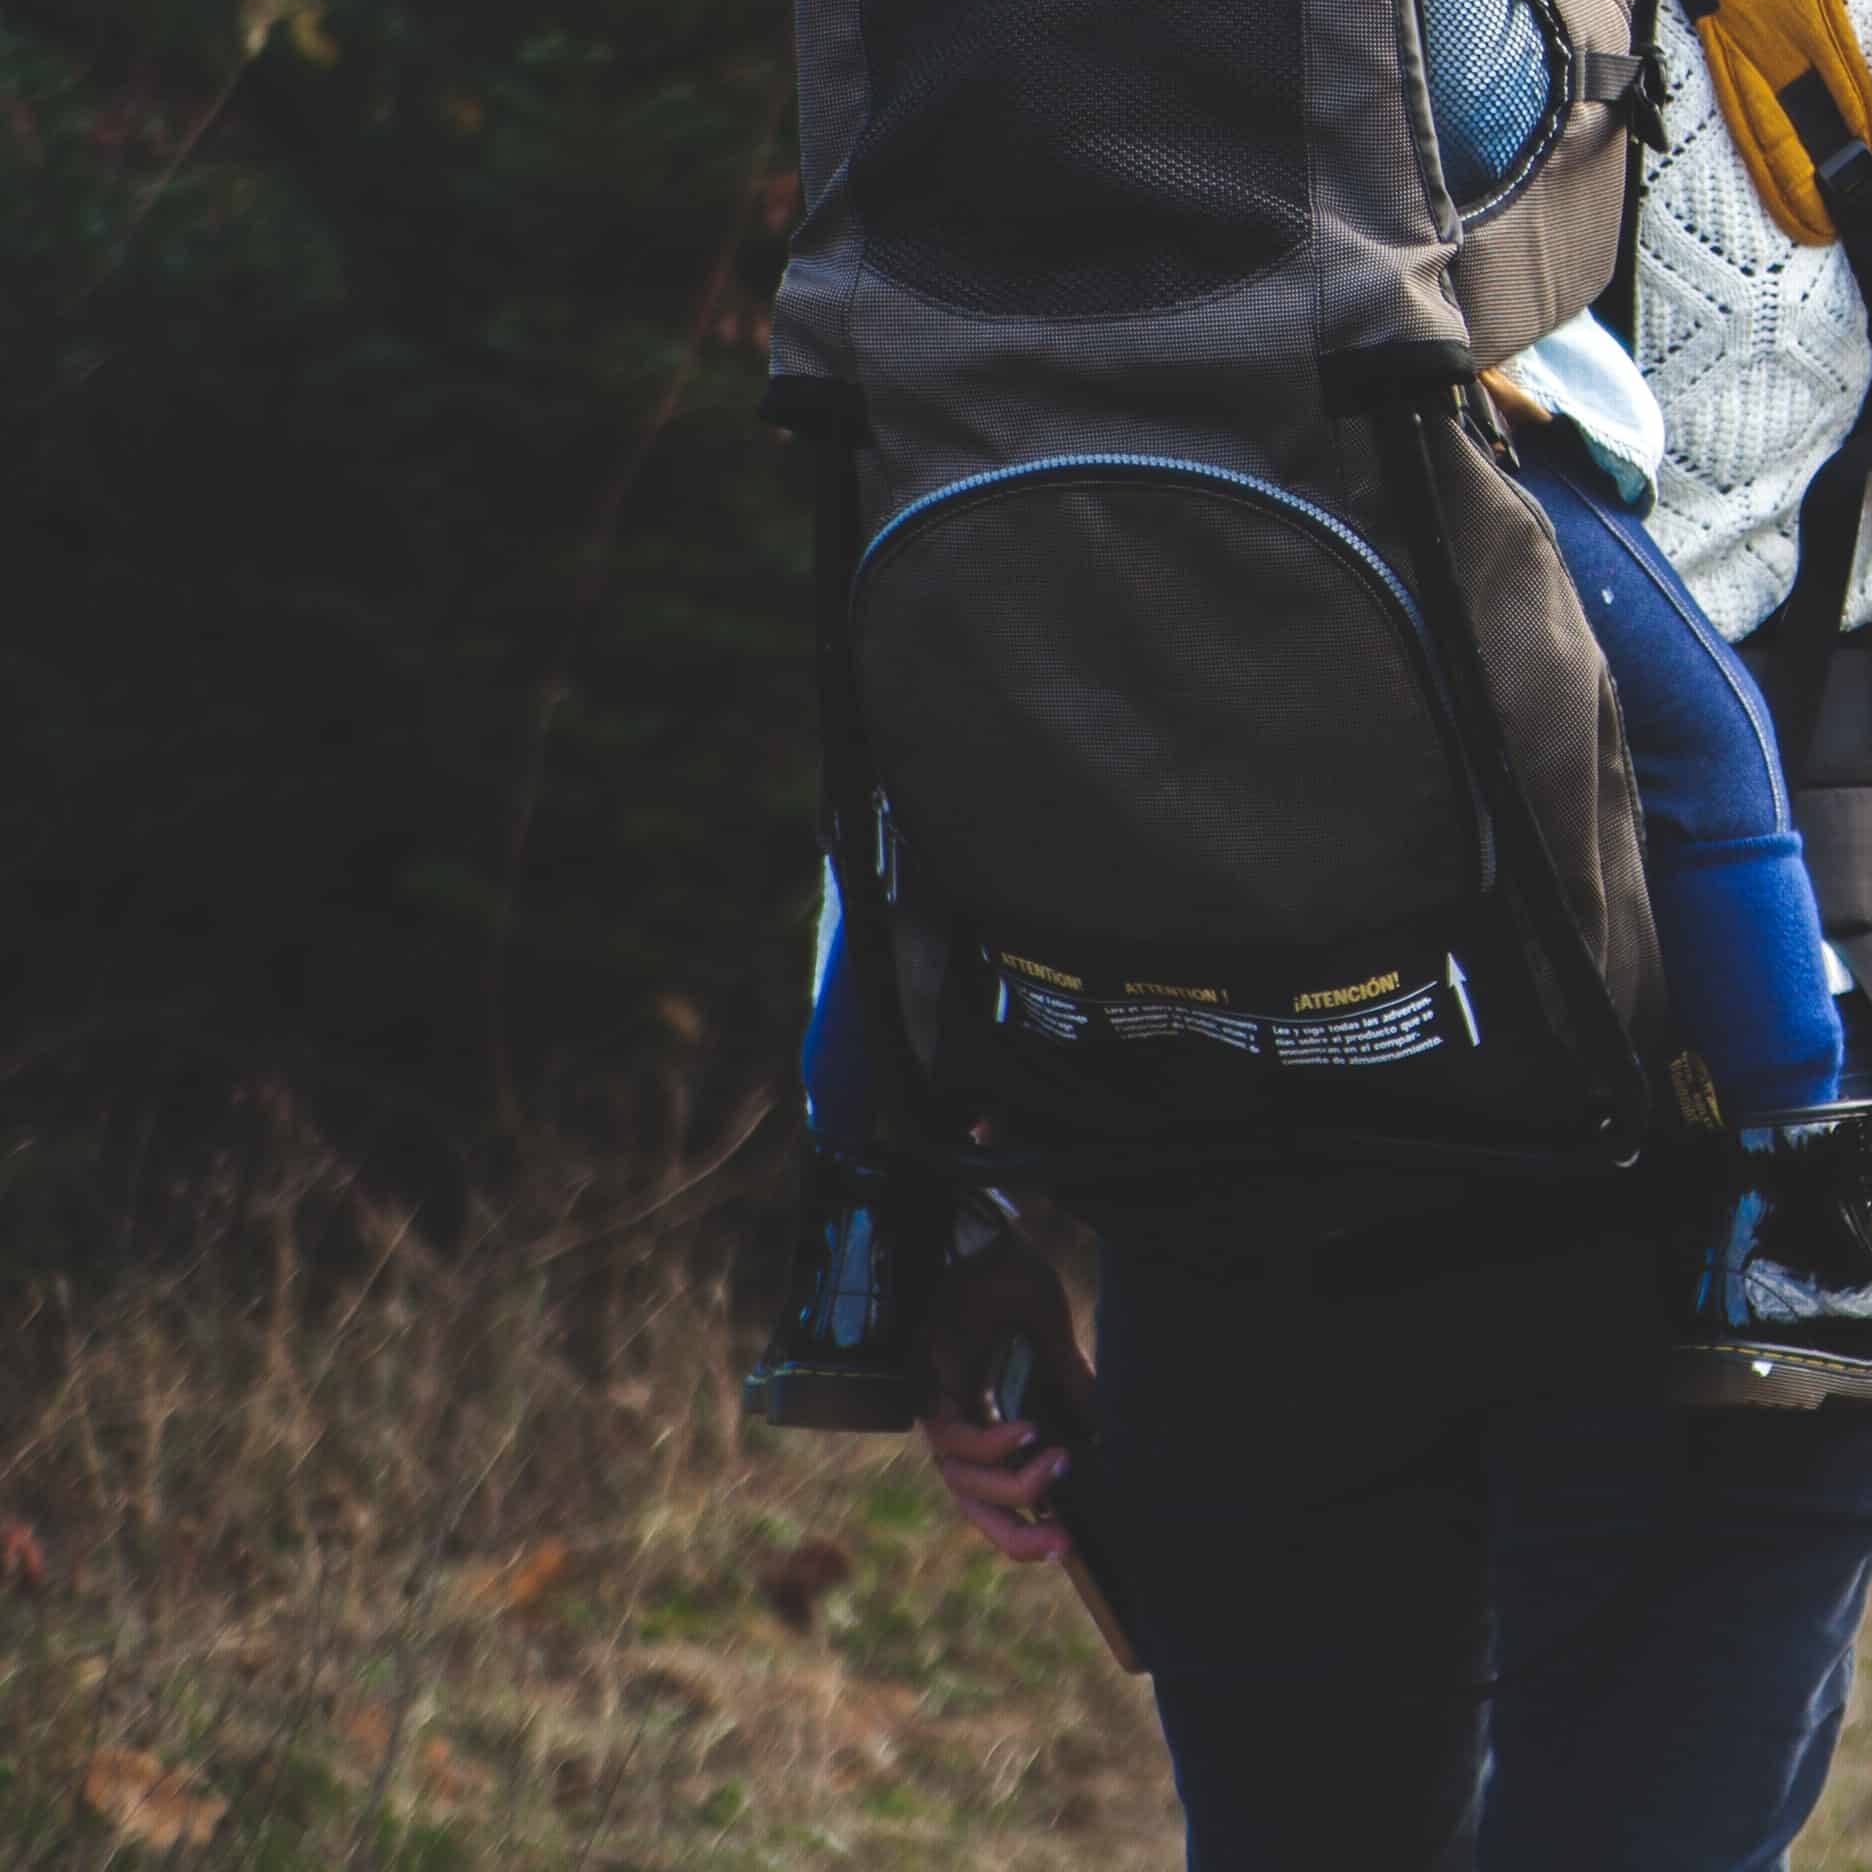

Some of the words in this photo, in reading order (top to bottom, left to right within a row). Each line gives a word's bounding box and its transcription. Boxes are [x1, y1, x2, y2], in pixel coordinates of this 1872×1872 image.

[1293, 970, 1401, 1013] ¡ATENCIÓN!
[1344, 1025, 1398, 1045] producto
[1399, 1015, 1421, 1033] que
